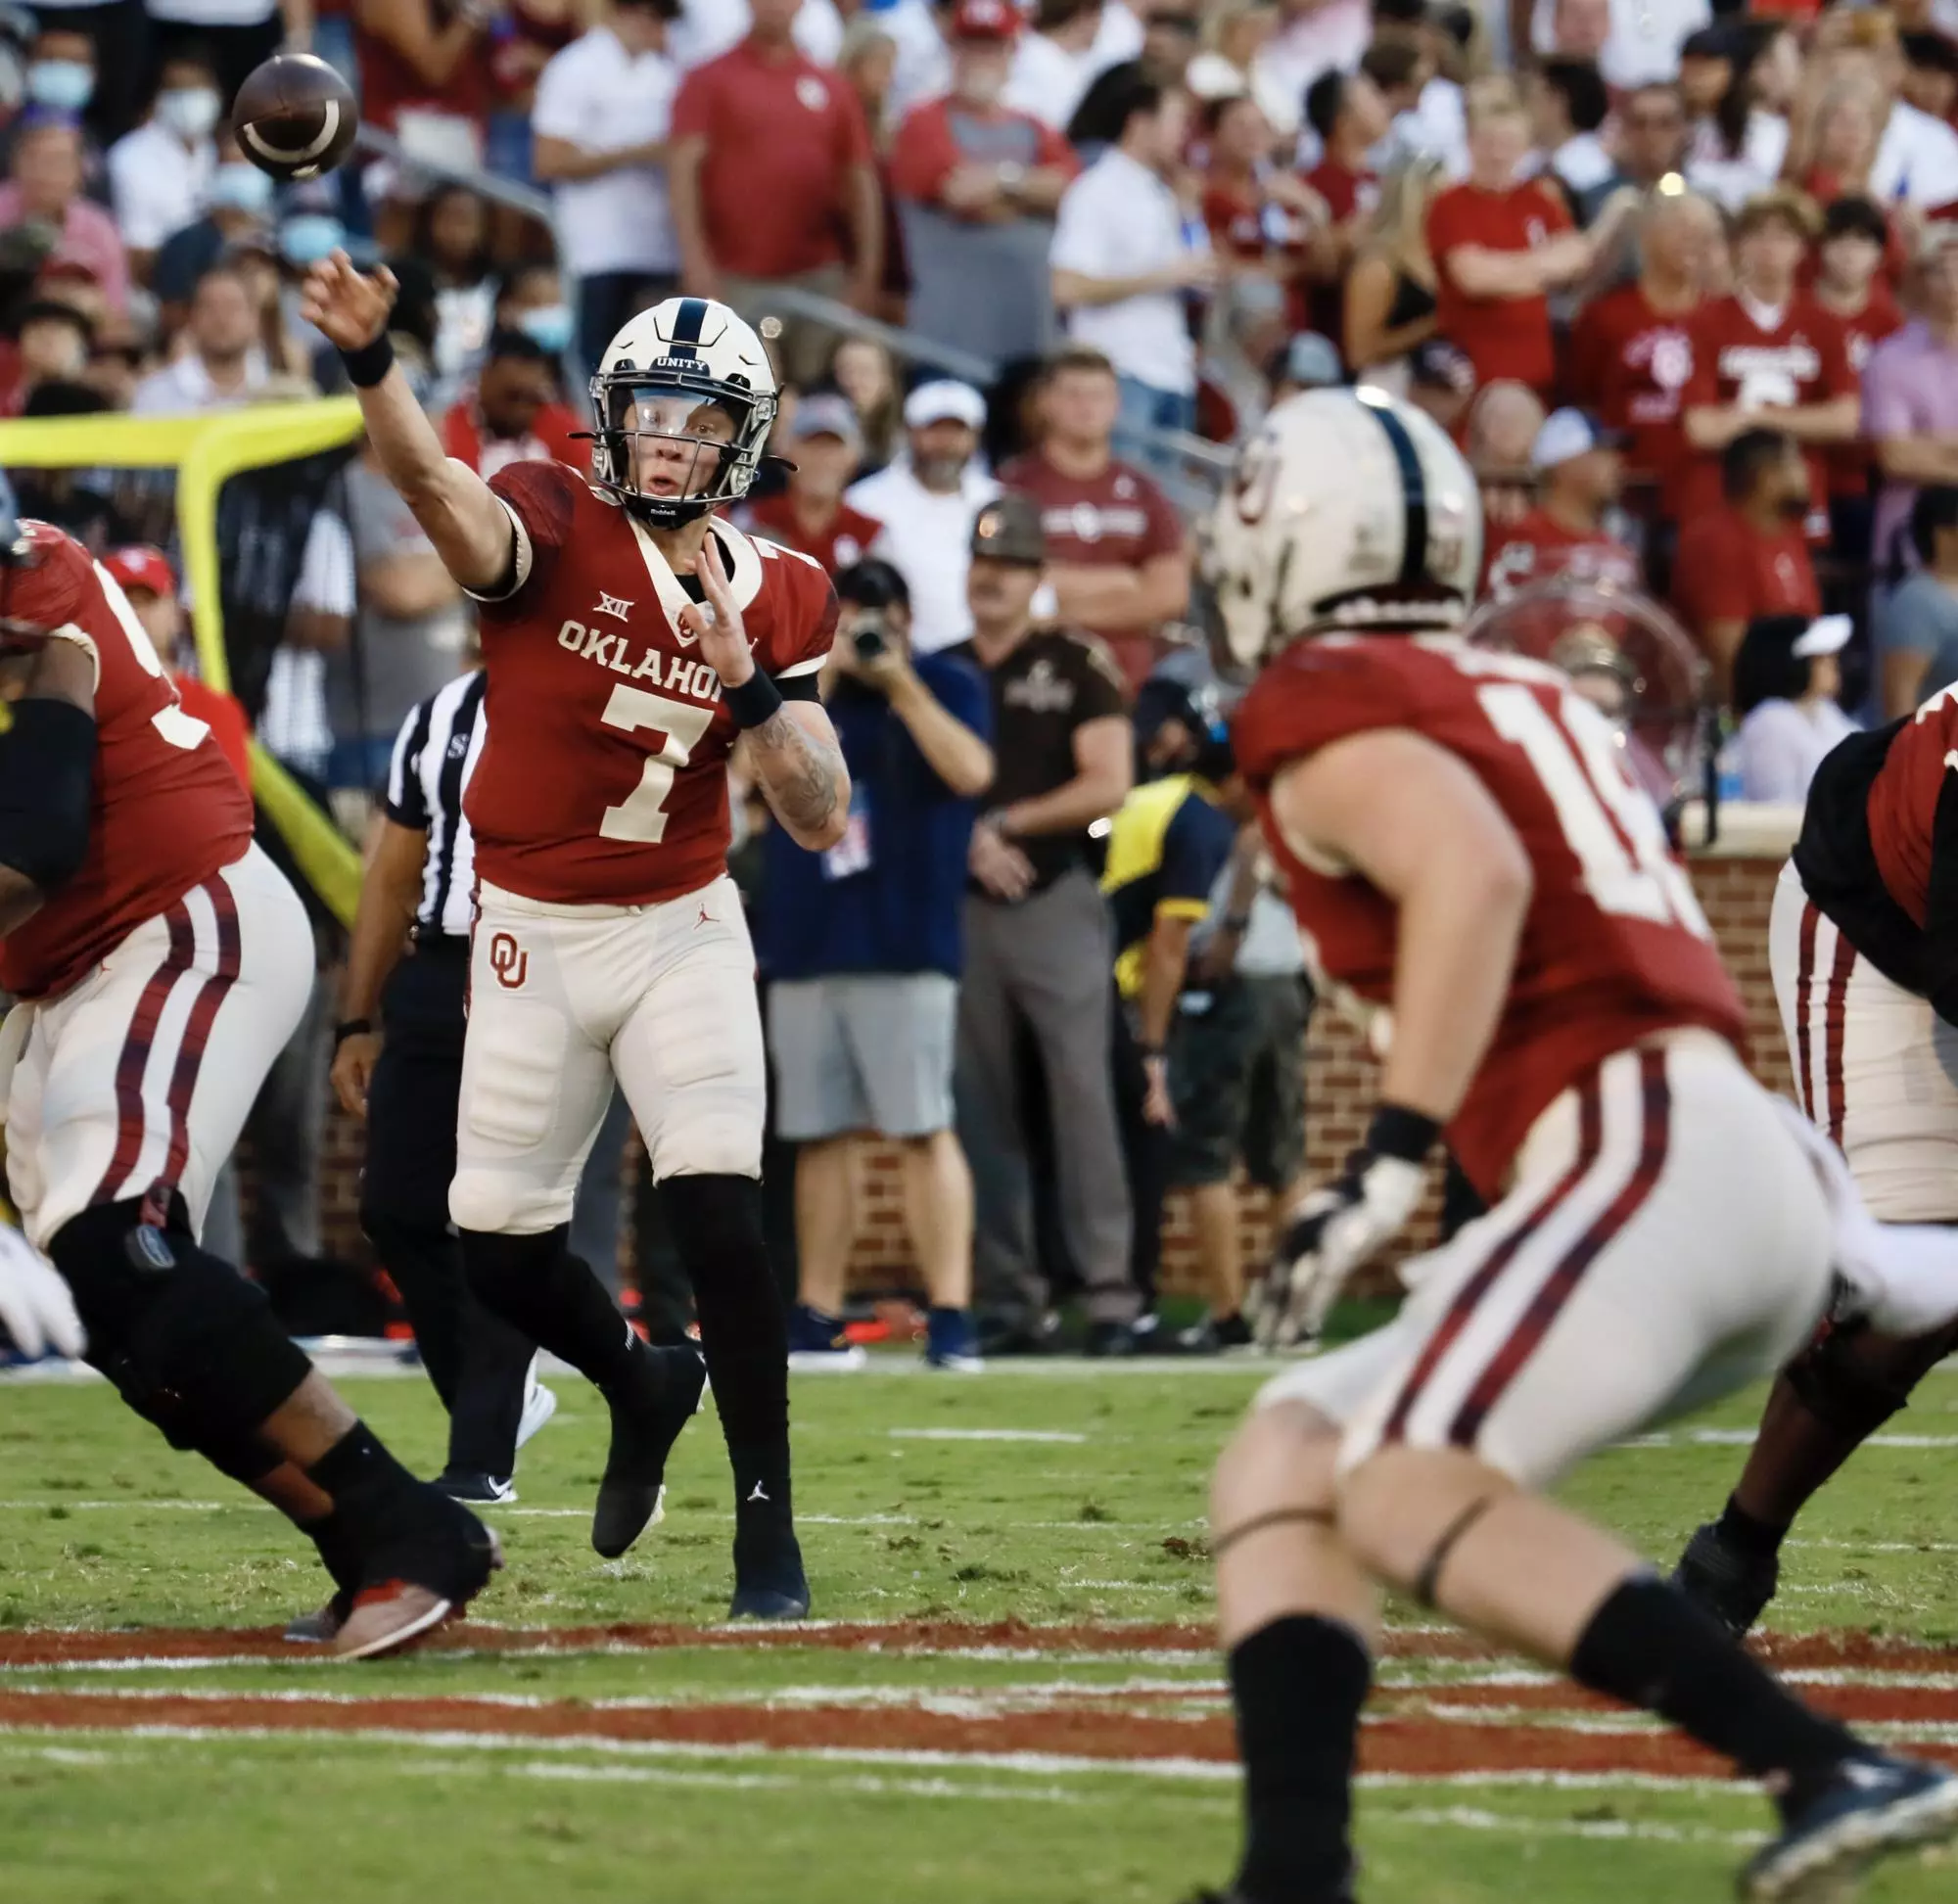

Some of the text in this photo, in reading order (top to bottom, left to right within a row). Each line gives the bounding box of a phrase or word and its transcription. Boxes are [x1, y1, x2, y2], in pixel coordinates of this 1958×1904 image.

[657, 356, 706, 371] UNITY
[557, 619, 723, 703] OKLAHO
[599, 682, 716, 844] 7
[490, 932, 528, 989] OU
